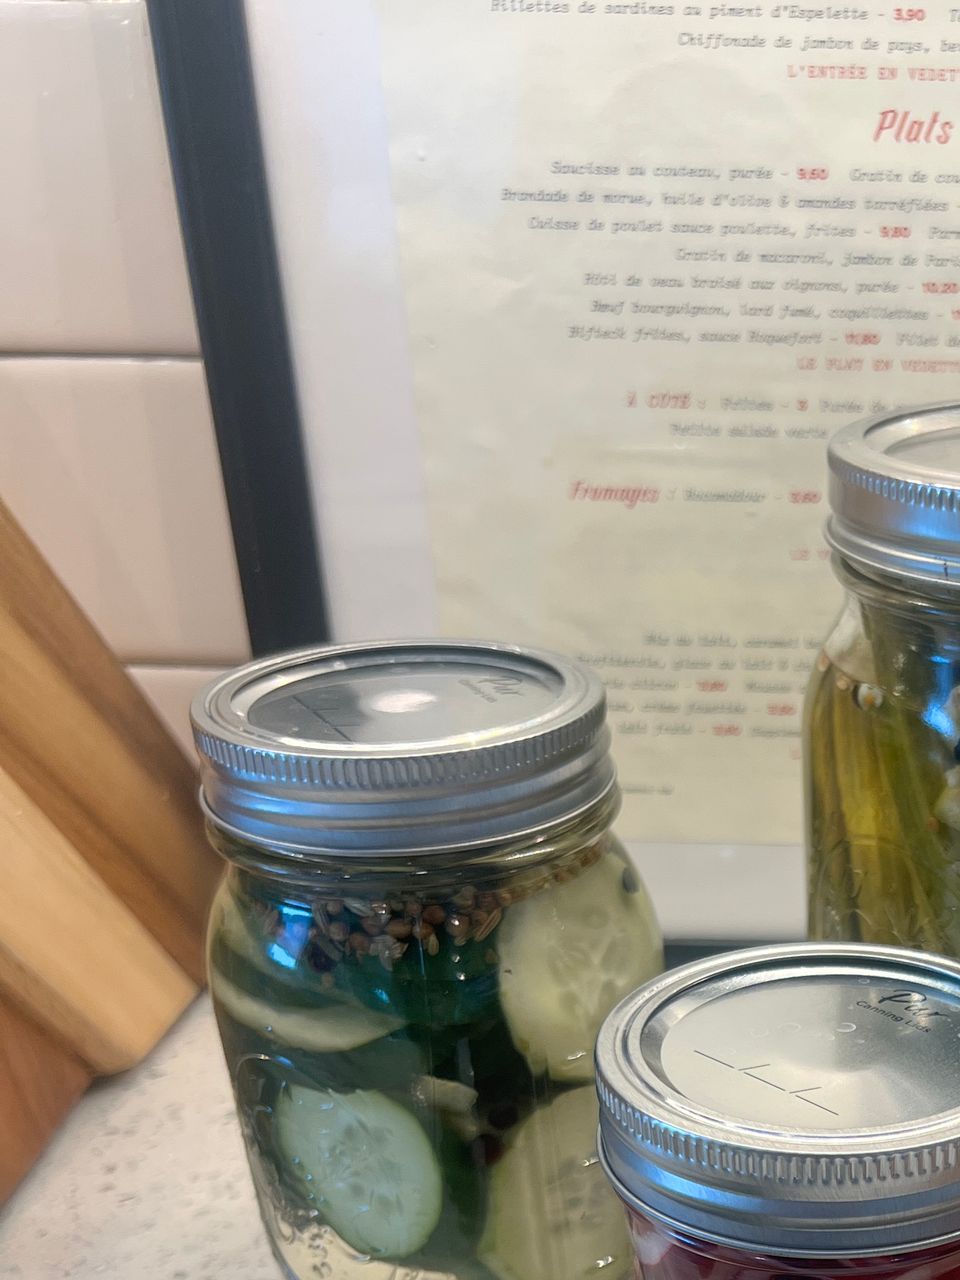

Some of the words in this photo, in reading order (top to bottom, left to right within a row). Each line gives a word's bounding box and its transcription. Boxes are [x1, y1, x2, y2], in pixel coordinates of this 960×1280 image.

[578, 1, 596, 14] de
[604, 2, 675, 16] sardines
[683, 6, 701, 16] au
[708, 4, 763, 19] piment
[770, 5, 869, 21] d'Espelette
[893, 8, 926, 22] 3,90
[677, 32, 767, 49] Chiffonade
[773, 34, 792, 48] de
[800, 36, 854, 51] jambon
[861, 37, 880, 50] de
[887, 40, 930, 54] pays,
[787, 64, 868, 80] L'ENTRÉE
[877, 66, 898, 80] EN
[872, 109, 954, 145] Plats
[550, 160, 619, 175] Saucisse
[627, 166, 645, 176] au
[653, 166, 720, 180] couteau,
[729, 166, 773, 181] purée
[849, 168, 902, 182] Gratin
[909, 170, 928, 184] de
[500, 188, 568, 202] Brandade
[576, 190, 594, 203] de
[602, 193, 653, 207] morue,
[662, 192, 704, 206] huile
[711, 193, 771, 208] d'olive
[796, 197, 856, 210] amandes
[863, 198, 949, 214] torréfiées
[528, 216, 580, 230] Cuisse
[586, 218, 605, 231] de
[611, 219, 664, 234] poulet
[671, 223, 714, 234] sauce
[720, 222, 796, 238] poulette,
[805, 223, 857, 239] frites
[675, 248, 727, 262] Gratin
[734, 250, 751, 263] de
[758, 252, 833, 266] macaroni,
[841, 251, 893, 267] jambon
[900, 254, 919, 267] de
[624, 274, 643, 287] de
[877, 989, 948, 1019] Pur
[856, 1000, 902, 1023] Canning
[904, 1018, 931, 1033] Lids
